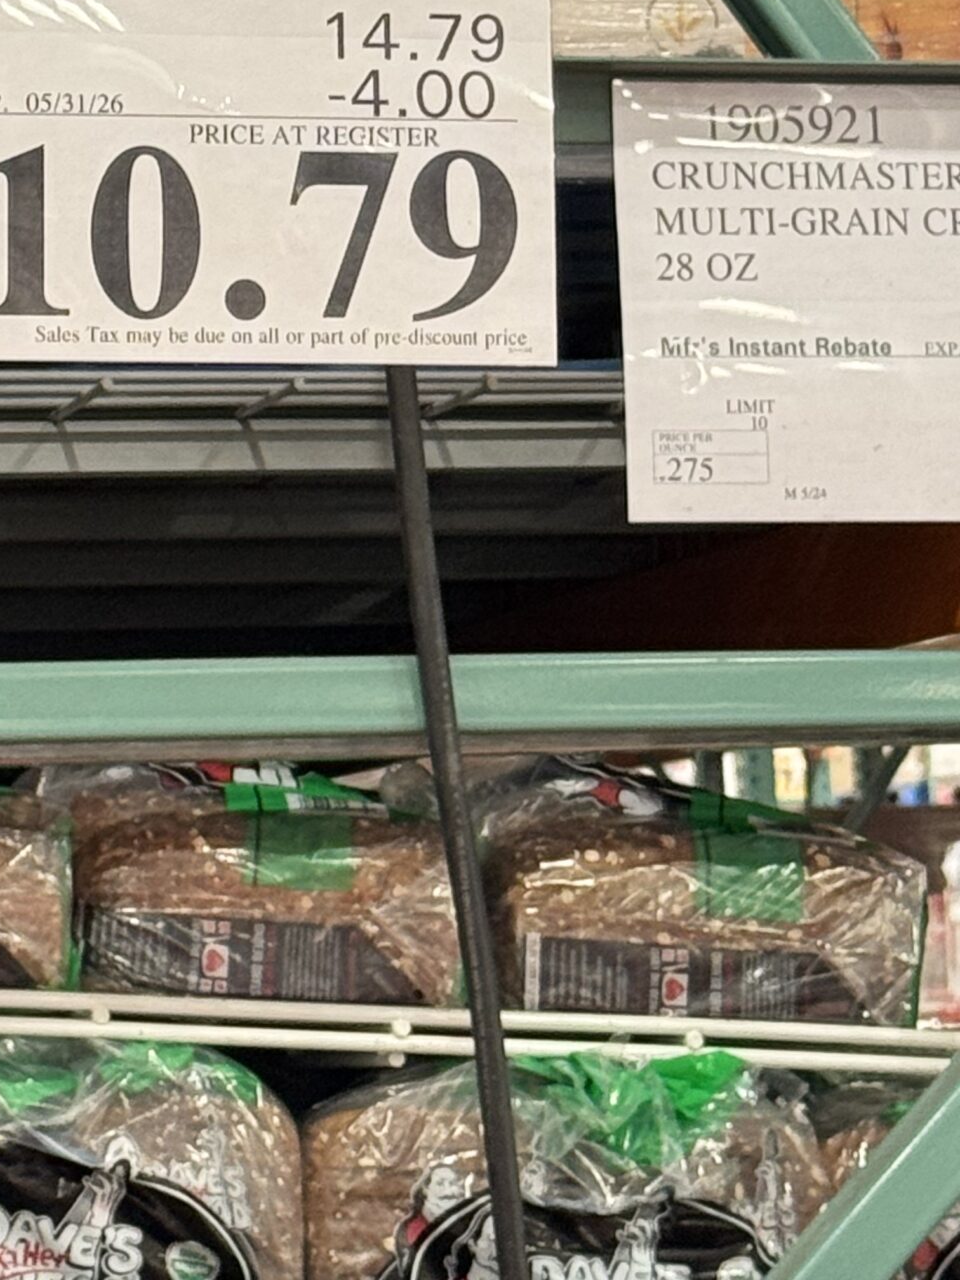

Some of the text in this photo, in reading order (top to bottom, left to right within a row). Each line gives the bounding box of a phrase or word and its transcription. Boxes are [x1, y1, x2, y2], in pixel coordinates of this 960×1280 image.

[326, 11, 505, 63] 14.79
[25, 92, 125, 114] 05/31/26
[328, 69, 496, 119] -4.00
[189, 123, 440, 148] PRICE AT REGISTER
[704, 104, 883, 145] 1905921
[652, 161, 960, 190] CRUNCHMASTER
[655, 207, 909, 236] MULTI-GRAIN
[656, 252, 759, 282] 28 OZ
[35, 325, 80, 344] Sales
[86, 326, 120, 344] Tax
[126, 330, 162, 349] may
[168, 326, 190, 345] be
[194, 326, 226, 345] due
[231, 331, 253, 345] on
[258, 326, 280, 345] all
[285, 331, 304, 345] or
[309, 328, 344, 350] part
[349, 326, 368, 346] of
[373, 326, 479, 351] pre-discount
[484, 328, 528, 350] price
[660, 336, 720, 358] Mfr's
[728, 337, 807, 358] Instant
[815, 336, 892, 358] Rebate
[725, 399, 776, 415] LIMIT
[751, 415, 769, 431] 10
[658, 457, 714, 483] .275
[783, 486, 798, 501] M
